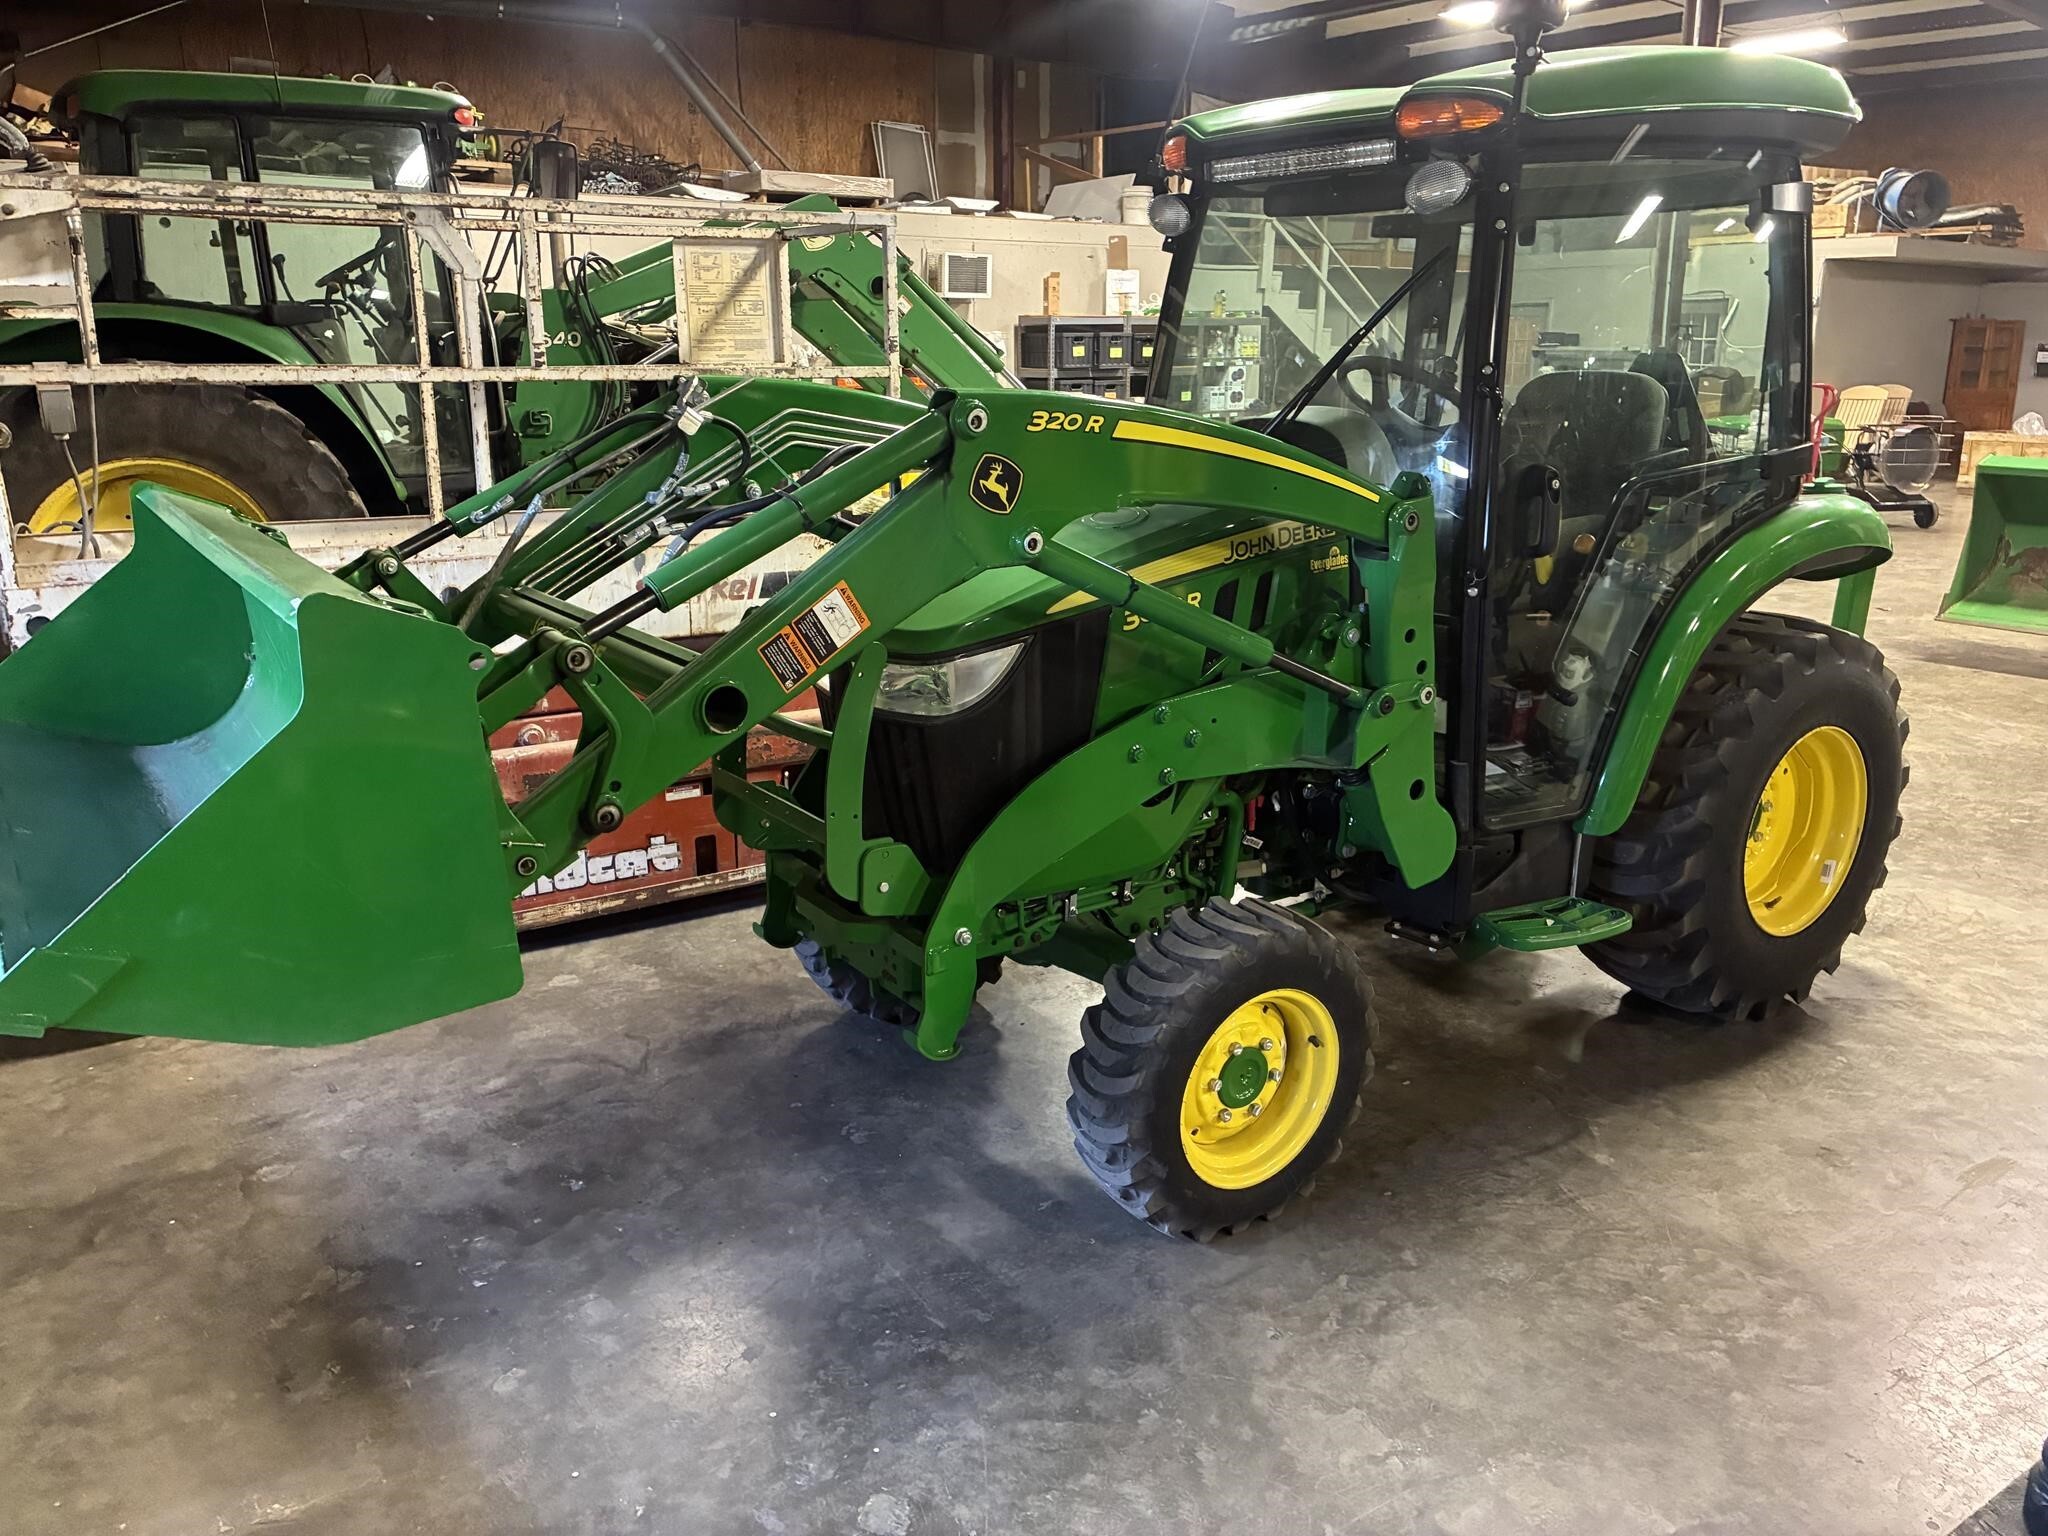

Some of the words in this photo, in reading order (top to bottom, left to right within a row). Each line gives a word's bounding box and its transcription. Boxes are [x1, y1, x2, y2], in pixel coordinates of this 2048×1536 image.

[1026, 410, 1083, 432] 320
[1084, 415, 1105, 433] R
[1224, 532, 1275, 562] JOHN
[1309, 554, 1349, 570] Everglades
[845, 594, 866, 624] WARNING
[789, 640, 811, 670] WARNING
